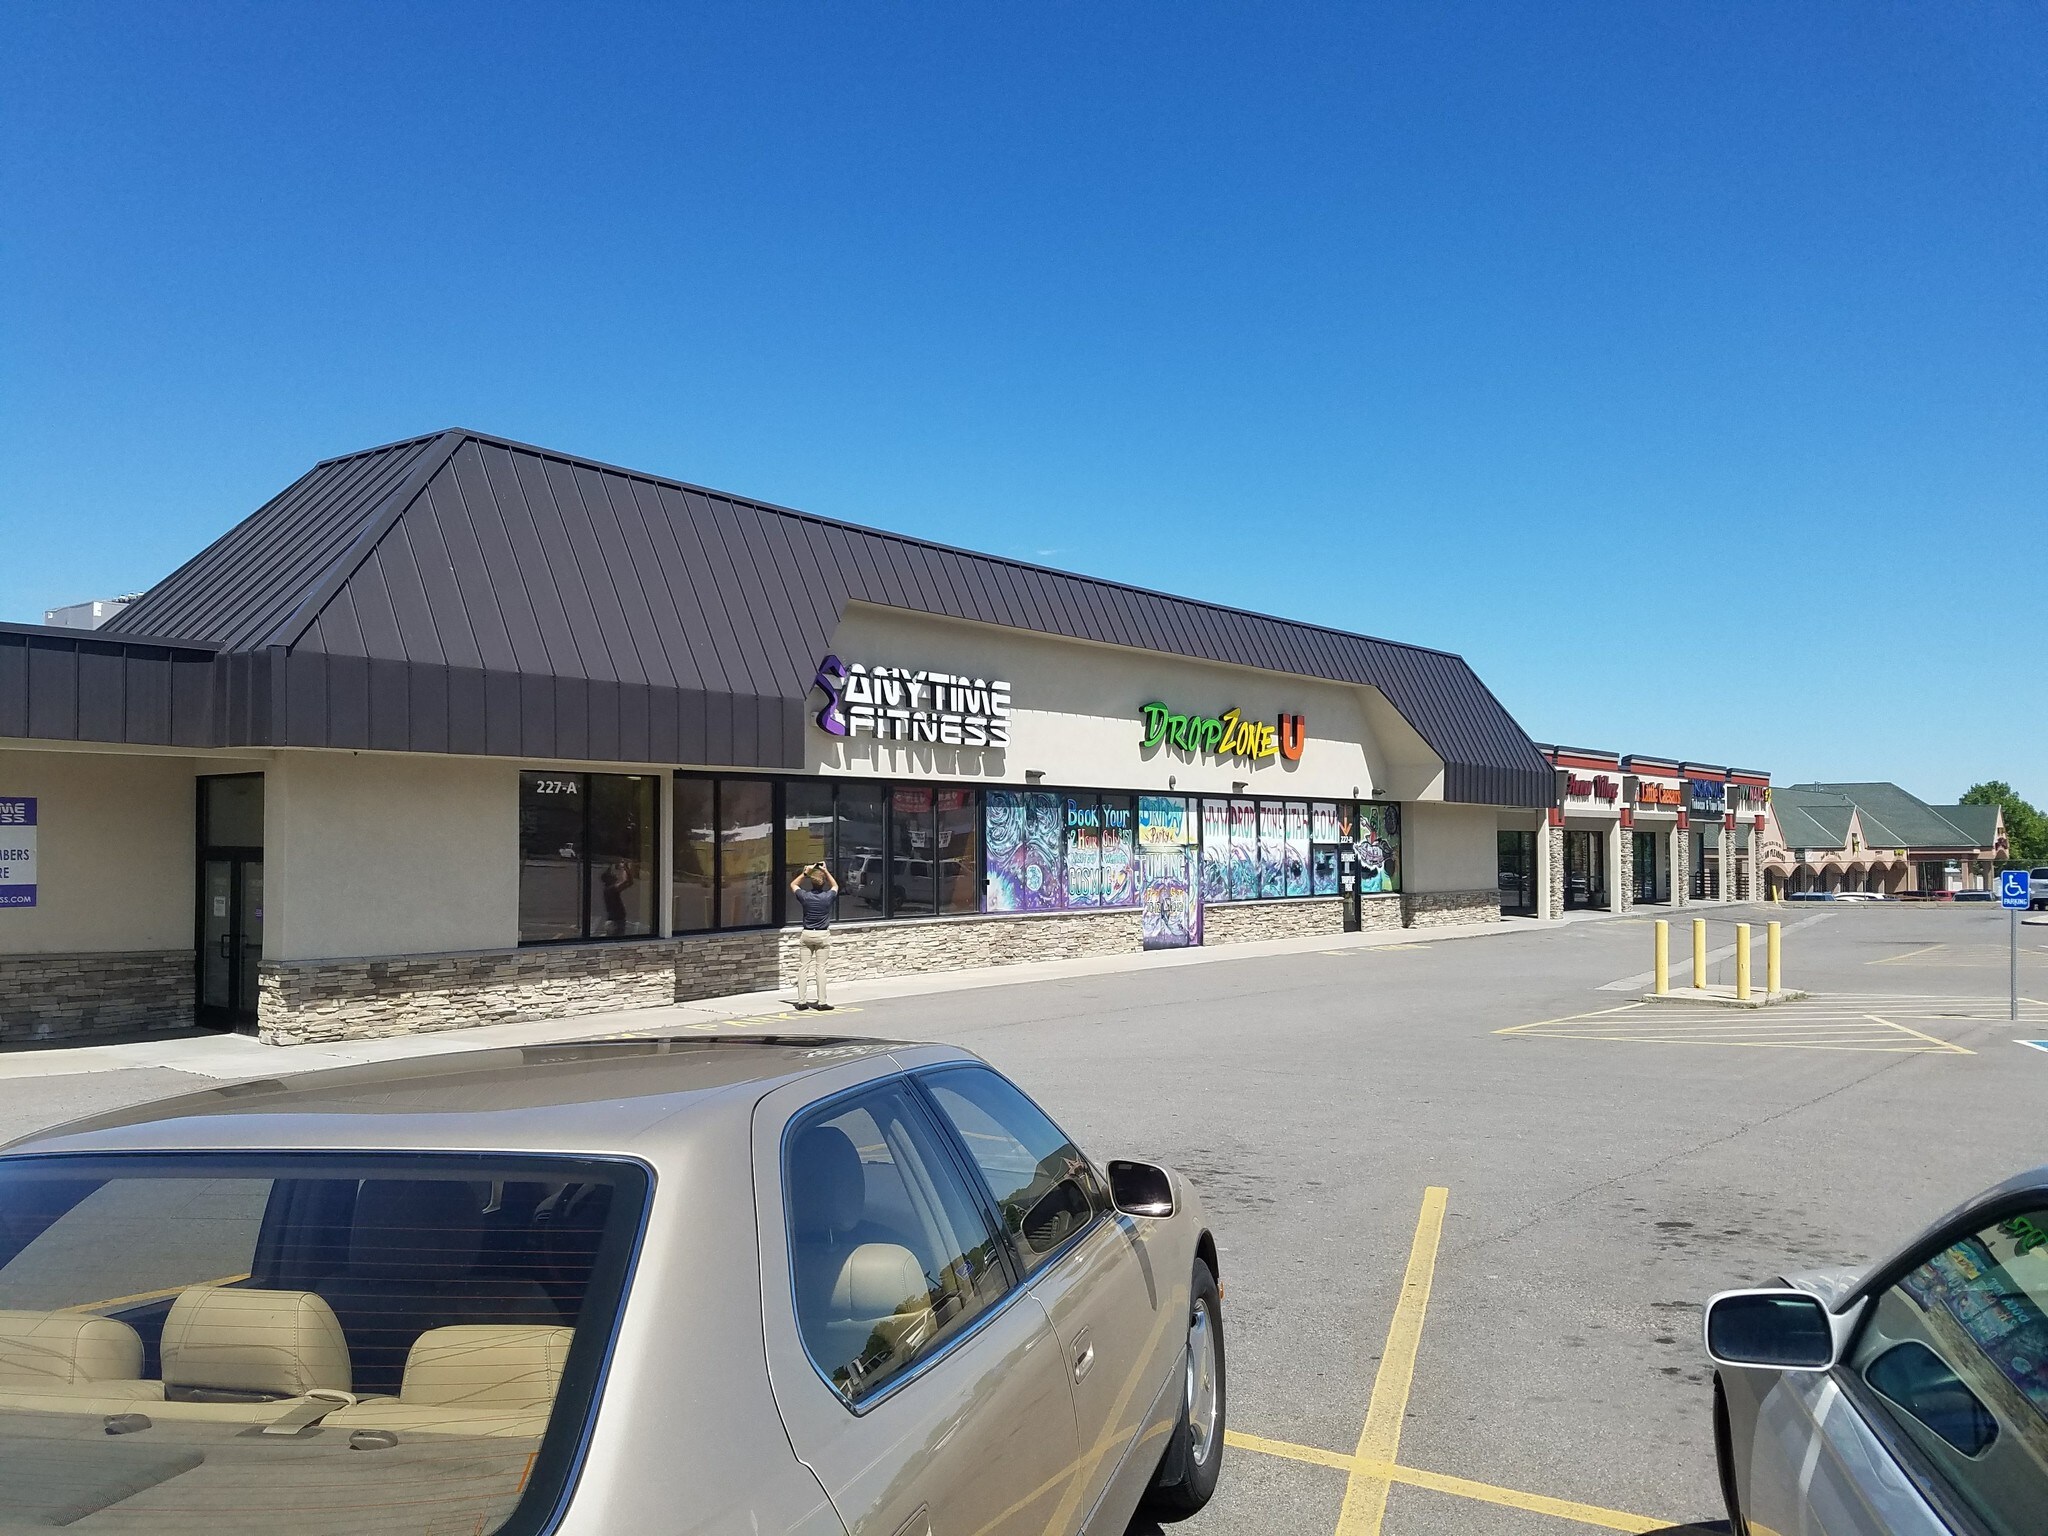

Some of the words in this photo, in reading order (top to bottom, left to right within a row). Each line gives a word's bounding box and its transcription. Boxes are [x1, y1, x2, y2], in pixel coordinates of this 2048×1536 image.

[843, 662, 1011, 717] ANYTIME
[848, 705, 1012, 748] FITNESS
[1278, 713, 1305, 761] U
[536, 780, 577, 794] 227-A
[1640, 782, 1658, 803] Little
